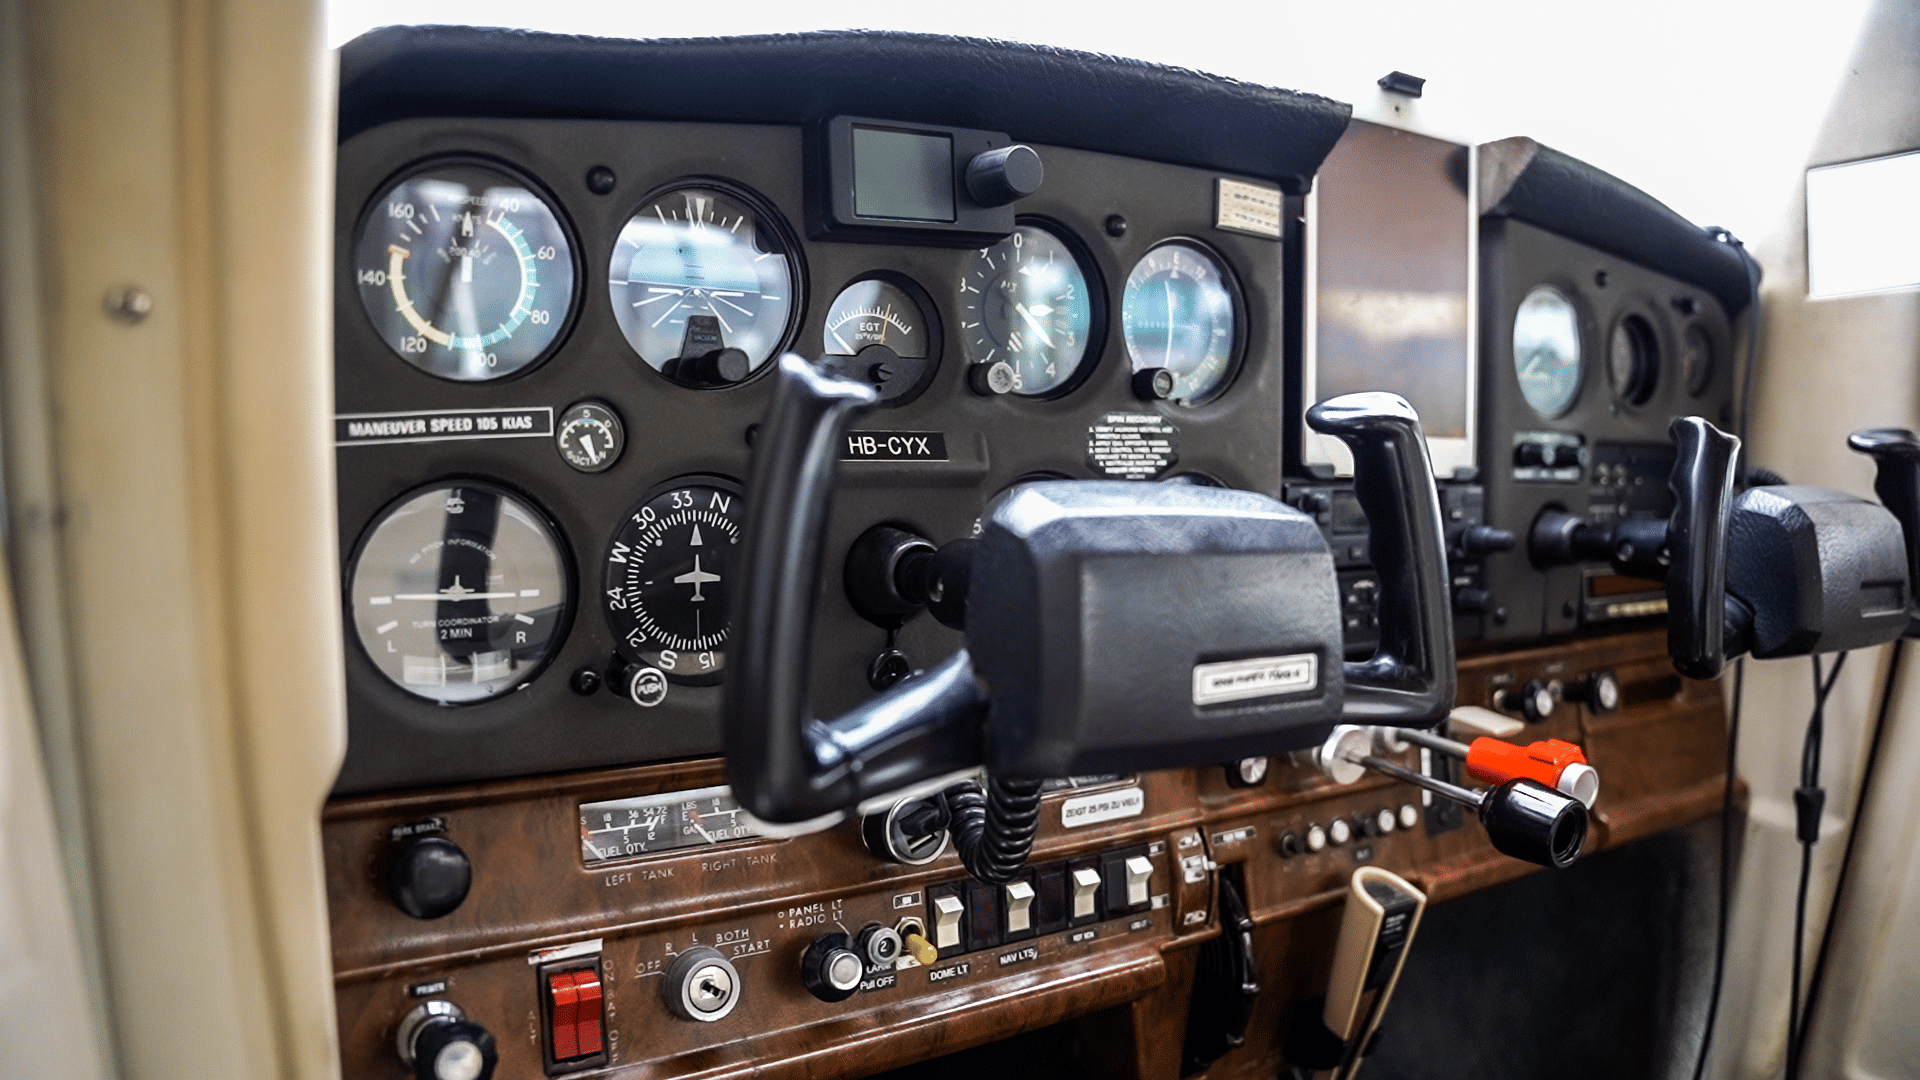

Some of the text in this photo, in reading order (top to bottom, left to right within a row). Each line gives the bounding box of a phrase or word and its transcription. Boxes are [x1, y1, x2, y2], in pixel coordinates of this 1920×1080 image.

[388, 203, 414, 219] 160
[499, 198, 519, 212] 40
[1013, 233, 1023, 248] 0
[537, 246, 555, 260] 60
[357, 270, 385, 285] 140
[1066, 284, 1075, 300] 2
[531, 310, 549, 325] 80
[859, 322, 880, 332] EGT
[400, 337, 427, 352] 120
[1066, 331, 1075, 347] 3
[1045, 362, 1056, 378] 4
[1013, 374, 1023, 390] 5
[583, 409, 590, 418] 5
[1125, 415, 1162, 423] RECOVERY
[349, 416, 532, 437] MANEUVER SPEED 105 KIAS
[848, 436, 930, 455] HB-CYX
[566, 450, 606, 466] SUCTON
[671, 491, 693, 509] 33
[710, 491, 731, 514] N
[632, 506, 656, 530] 30
[609, 541, 630, 563] W
[607, 587, 627, 610] 24
[438, 615, 499, 627] COORDINATOR
[441, 628, 473, 640] 2 MIN
[516, 631, 527, 643] R
[626, 627, 647, 648] 21
[387, 640, 397, 652] L
[658, 650, 678, 670] S
[699, 651, 715, 669] 15
[637, 682, 663, 695] PUSH
[656, 806, 667, 814] 72
[682, 802, 697, 811] LBS
[1066, 806, 1087, 817] ZEIGT
[1088, 804, 1097, 813] 25
[1098, 803, 1109, 811] PSI
[1111, 801, 1120, 809] ZU
[603, 813, 612, 822] 18
[660, 815, 667, 825] F
[682, 812, 689, 821] E
[731, 818, 737, 827] 5
[623, 836, 629, 844] 5
[647, 832, 656, 840] 12
[702, 853, 777, 872] RIGHT TANK
[605, 868, 674, 887] LEFT TANK
[789, 899, 842, 917] PANEL LT
[789, 910, 843, 929] RADIO LT
[692, 933, 697, 941] L
[716, 929, 749, 943] BOTH
[665, 943, 672, 952] R
[734, 940, 770, 955] START
[880, 941, 887, 952] 2
[636, 960, 661, 973] OFF
[1000, 953, 1017, 965] NAV
[930, 964, 969, 981] DOME LT
[860, 976, 894, 991] Pull OFF
